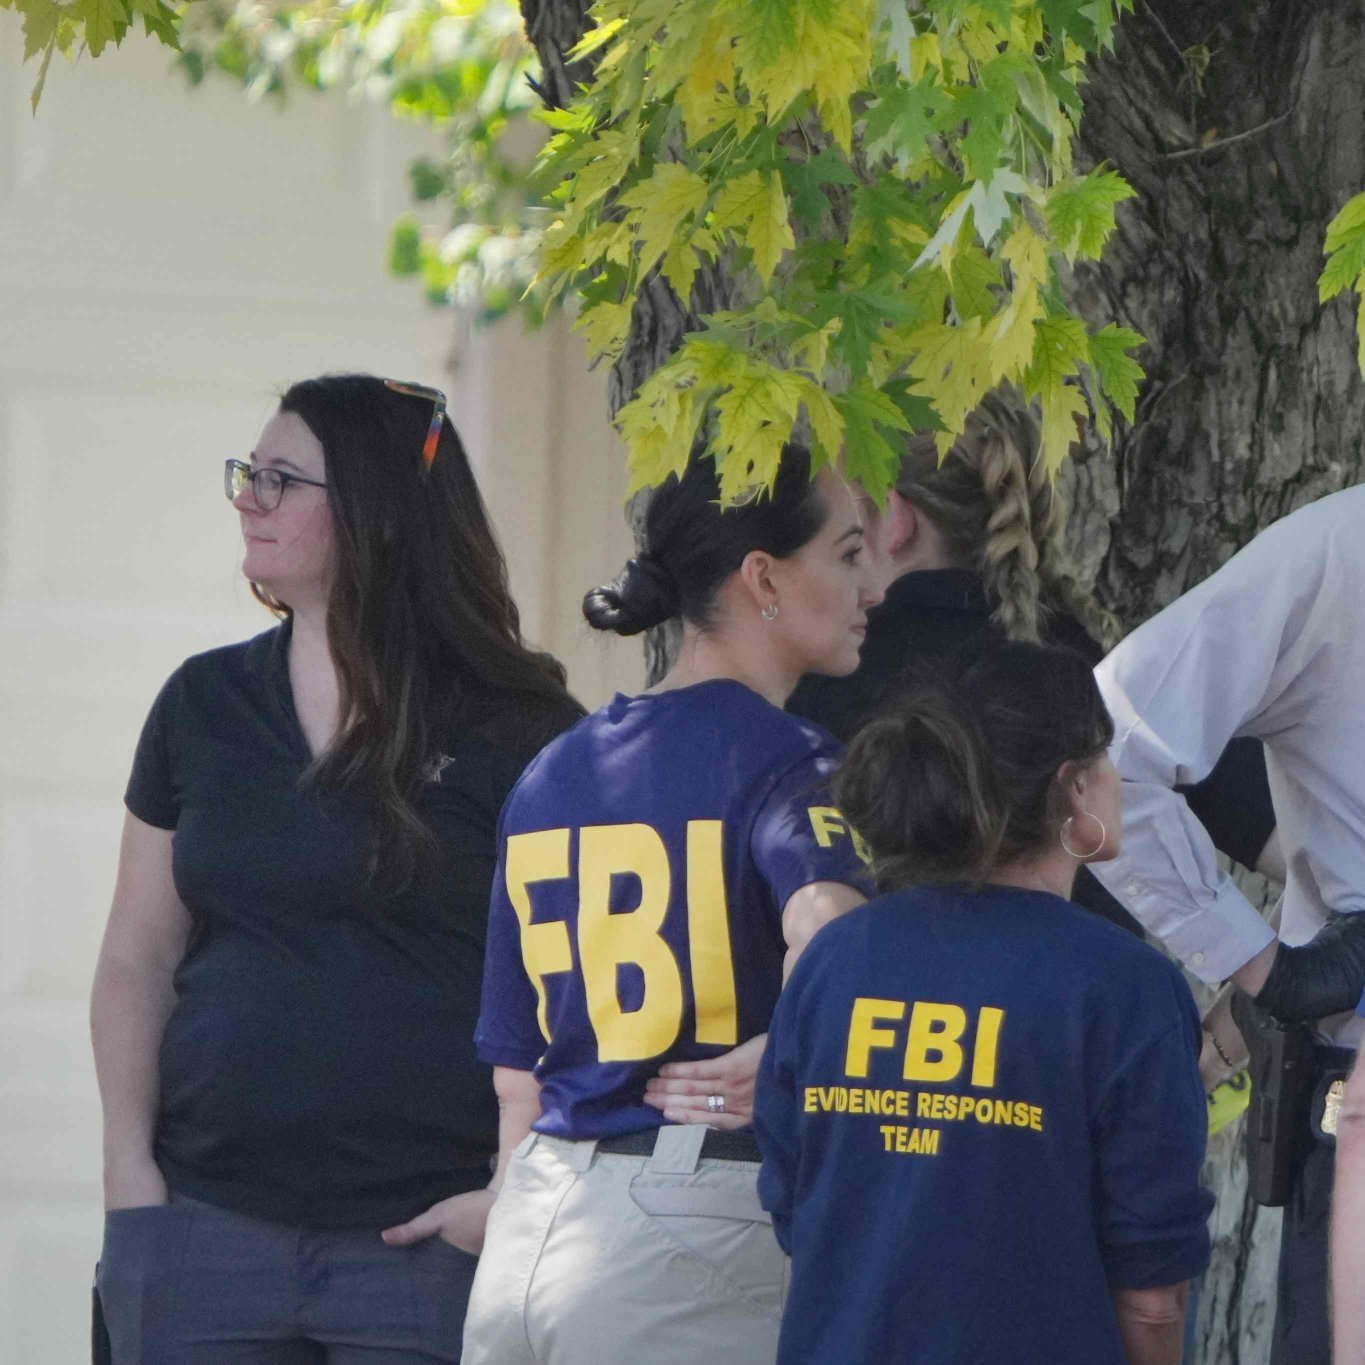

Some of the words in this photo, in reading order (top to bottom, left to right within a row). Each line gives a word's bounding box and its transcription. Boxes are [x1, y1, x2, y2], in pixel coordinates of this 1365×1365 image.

[505, 819, 738, 1064] FBI
[845, 998, 1004, 1088] FBI
[804, 1087, 909, 1117] EVIDENCE
[916, 1092, 1043, 1132] RESPONSE
[879, 1124, 941, 1156] TEAM
